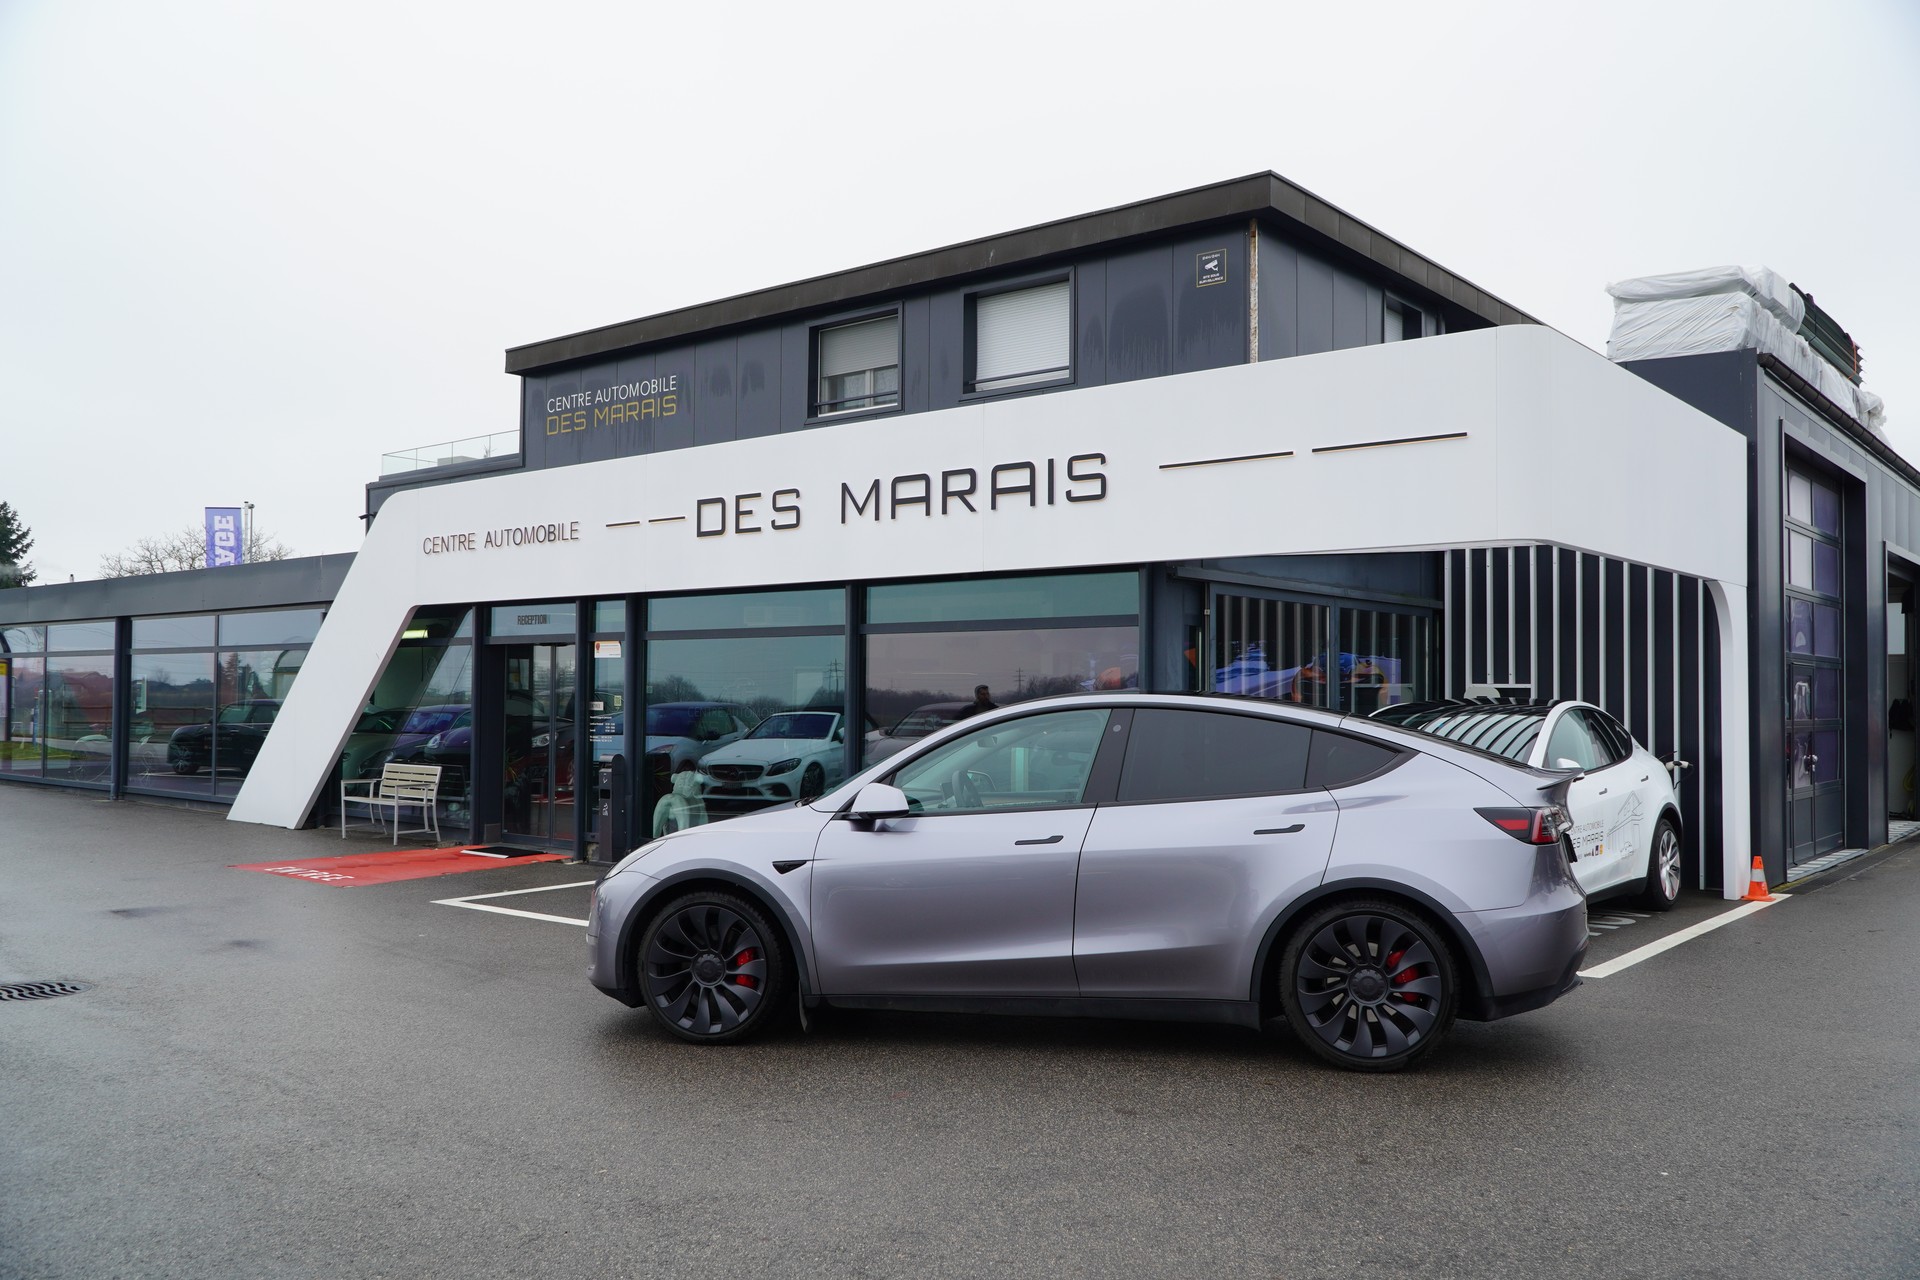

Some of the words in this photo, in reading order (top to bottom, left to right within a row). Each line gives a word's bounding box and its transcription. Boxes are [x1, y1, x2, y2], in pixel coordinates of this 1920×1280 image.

[547, 391, 592, 413] CENTRE
[595, 375, 677, 404] AUTOMOBILE
[546, 410, 587, 436] DES
[594, 395, 677, 428] MARAIS
[696, 488, 801, 538] DES
[841, 452, 1108, 525] MARAIS
[423, 532, 476, 555] CENTRE
[484, 521, 579, 549] AUTOMOBILE
